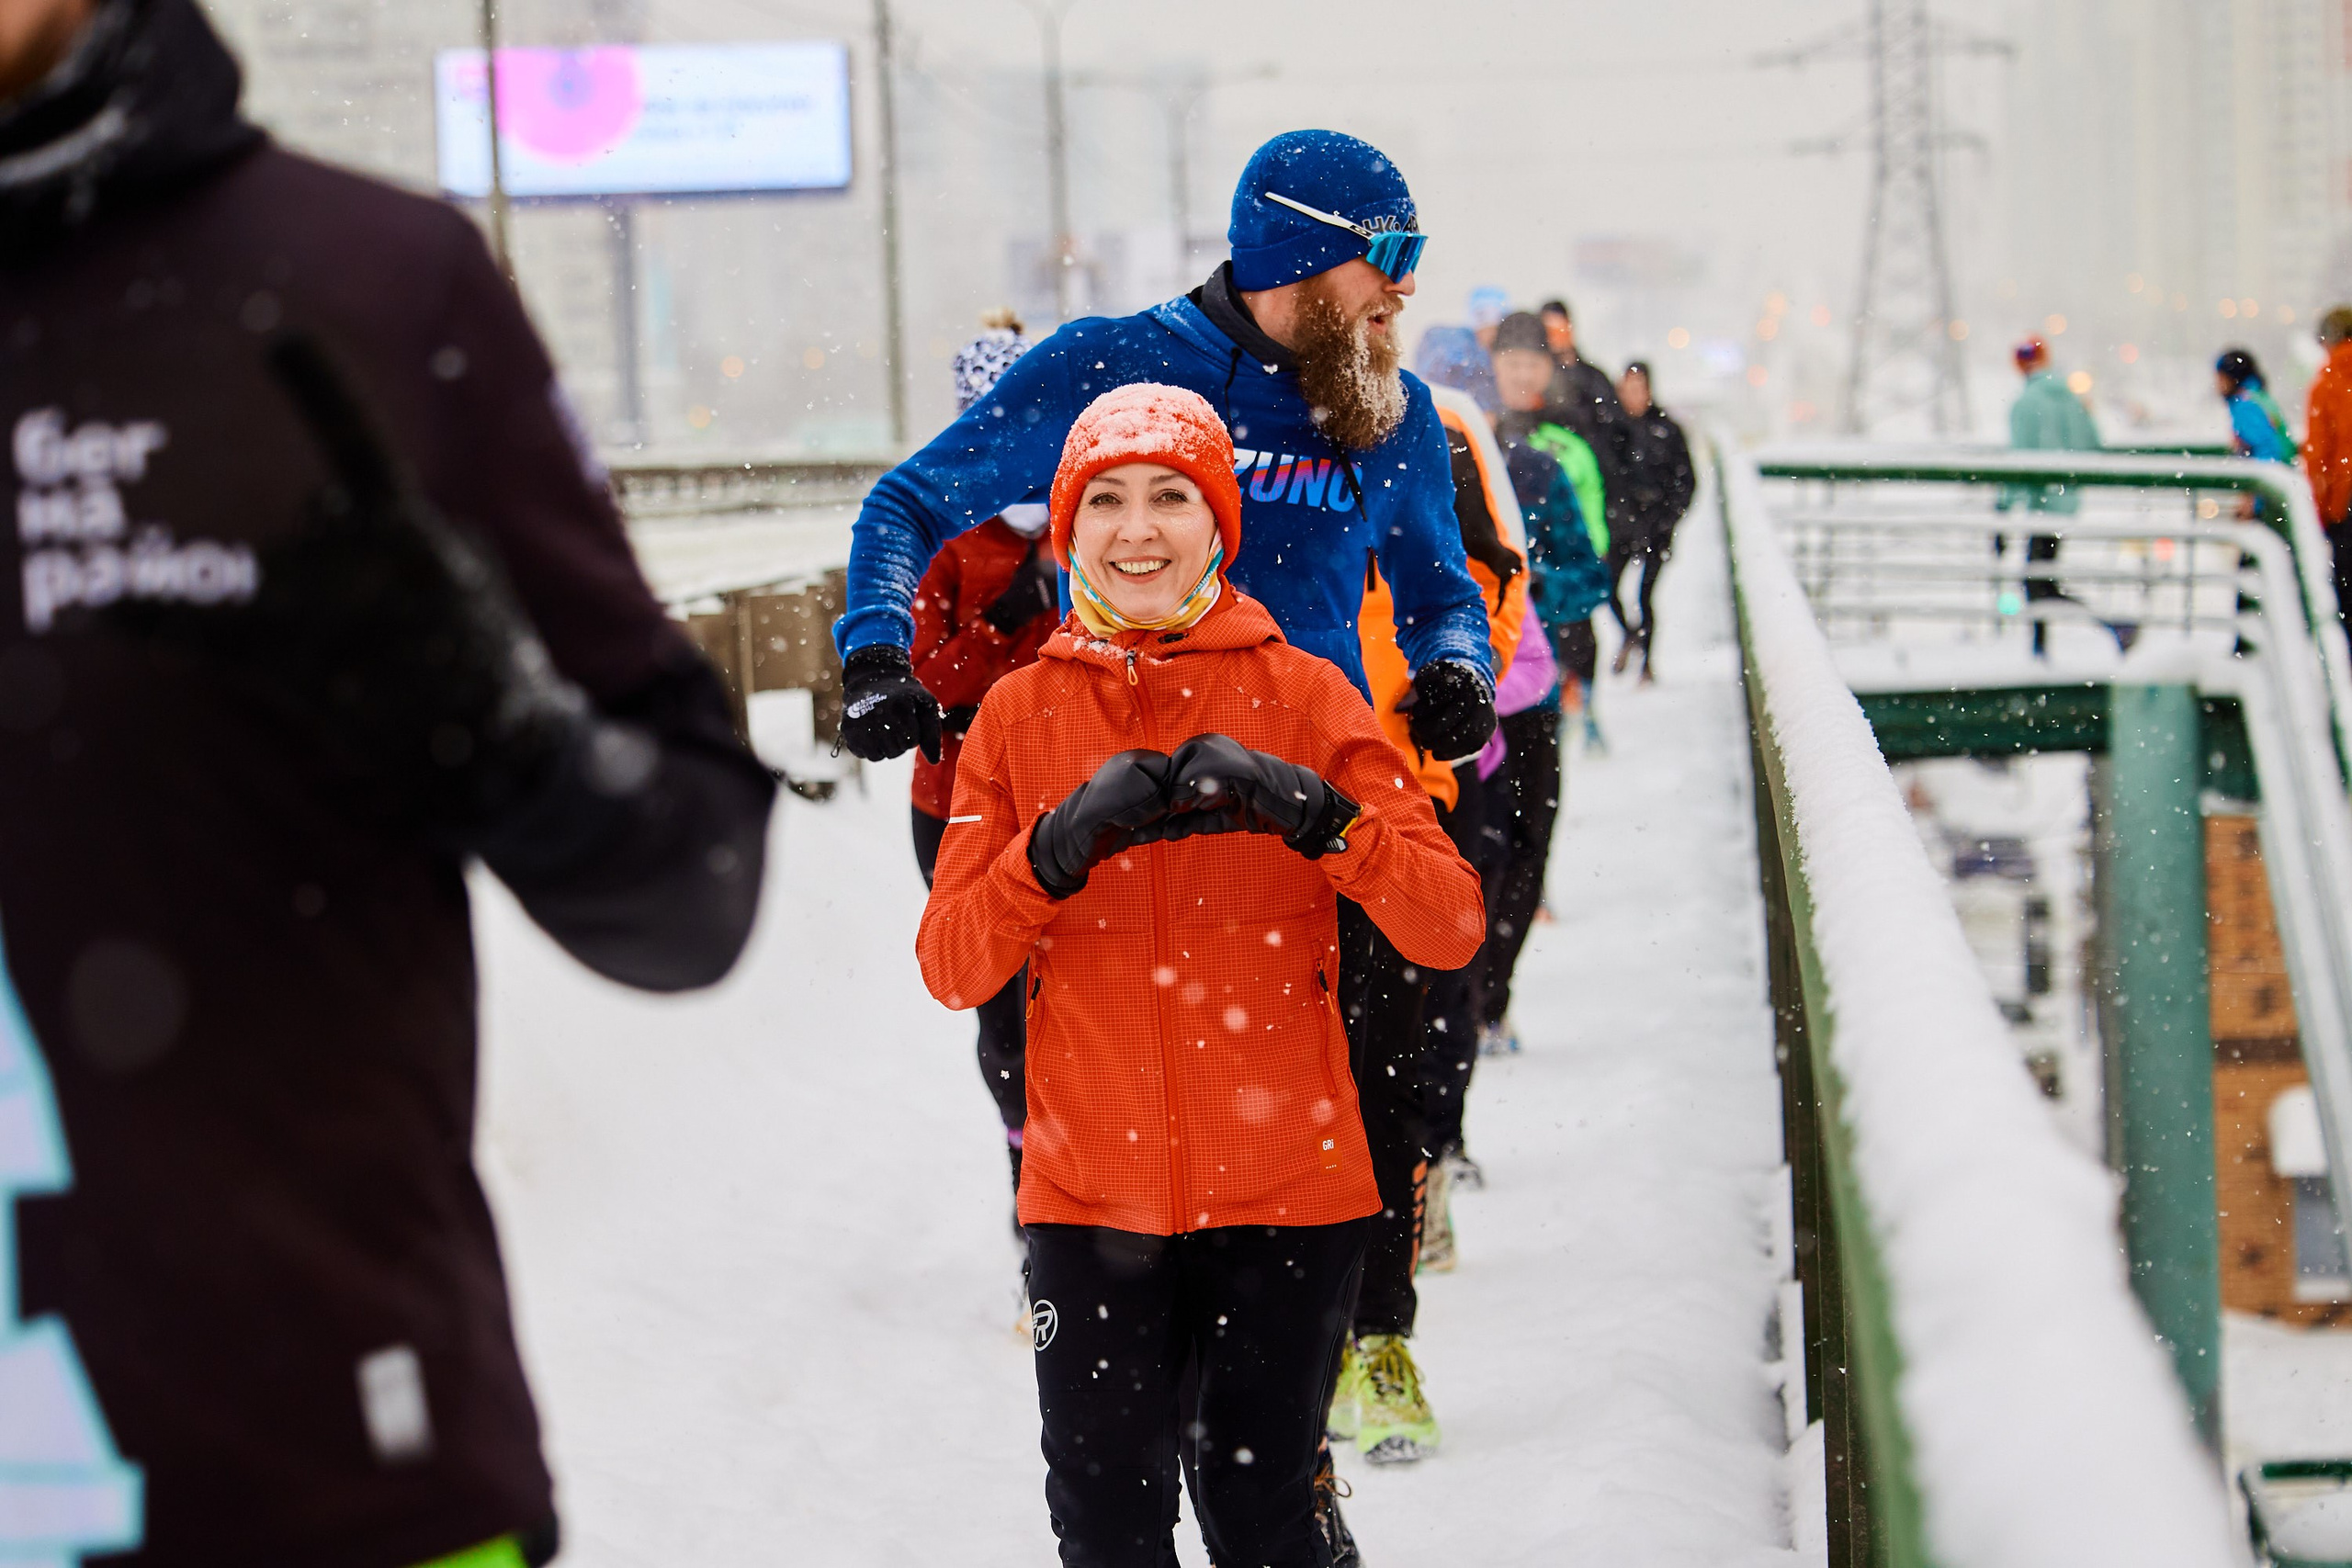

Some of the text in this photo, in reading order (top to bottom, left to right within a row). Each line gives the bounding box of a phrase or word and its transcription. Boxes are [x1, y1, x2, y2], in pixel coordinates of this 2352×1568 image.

[13, 409, 169, 483] бег
[1233, 448, 1363, 513] ZUNO
[17, 488, 125, 544] на
